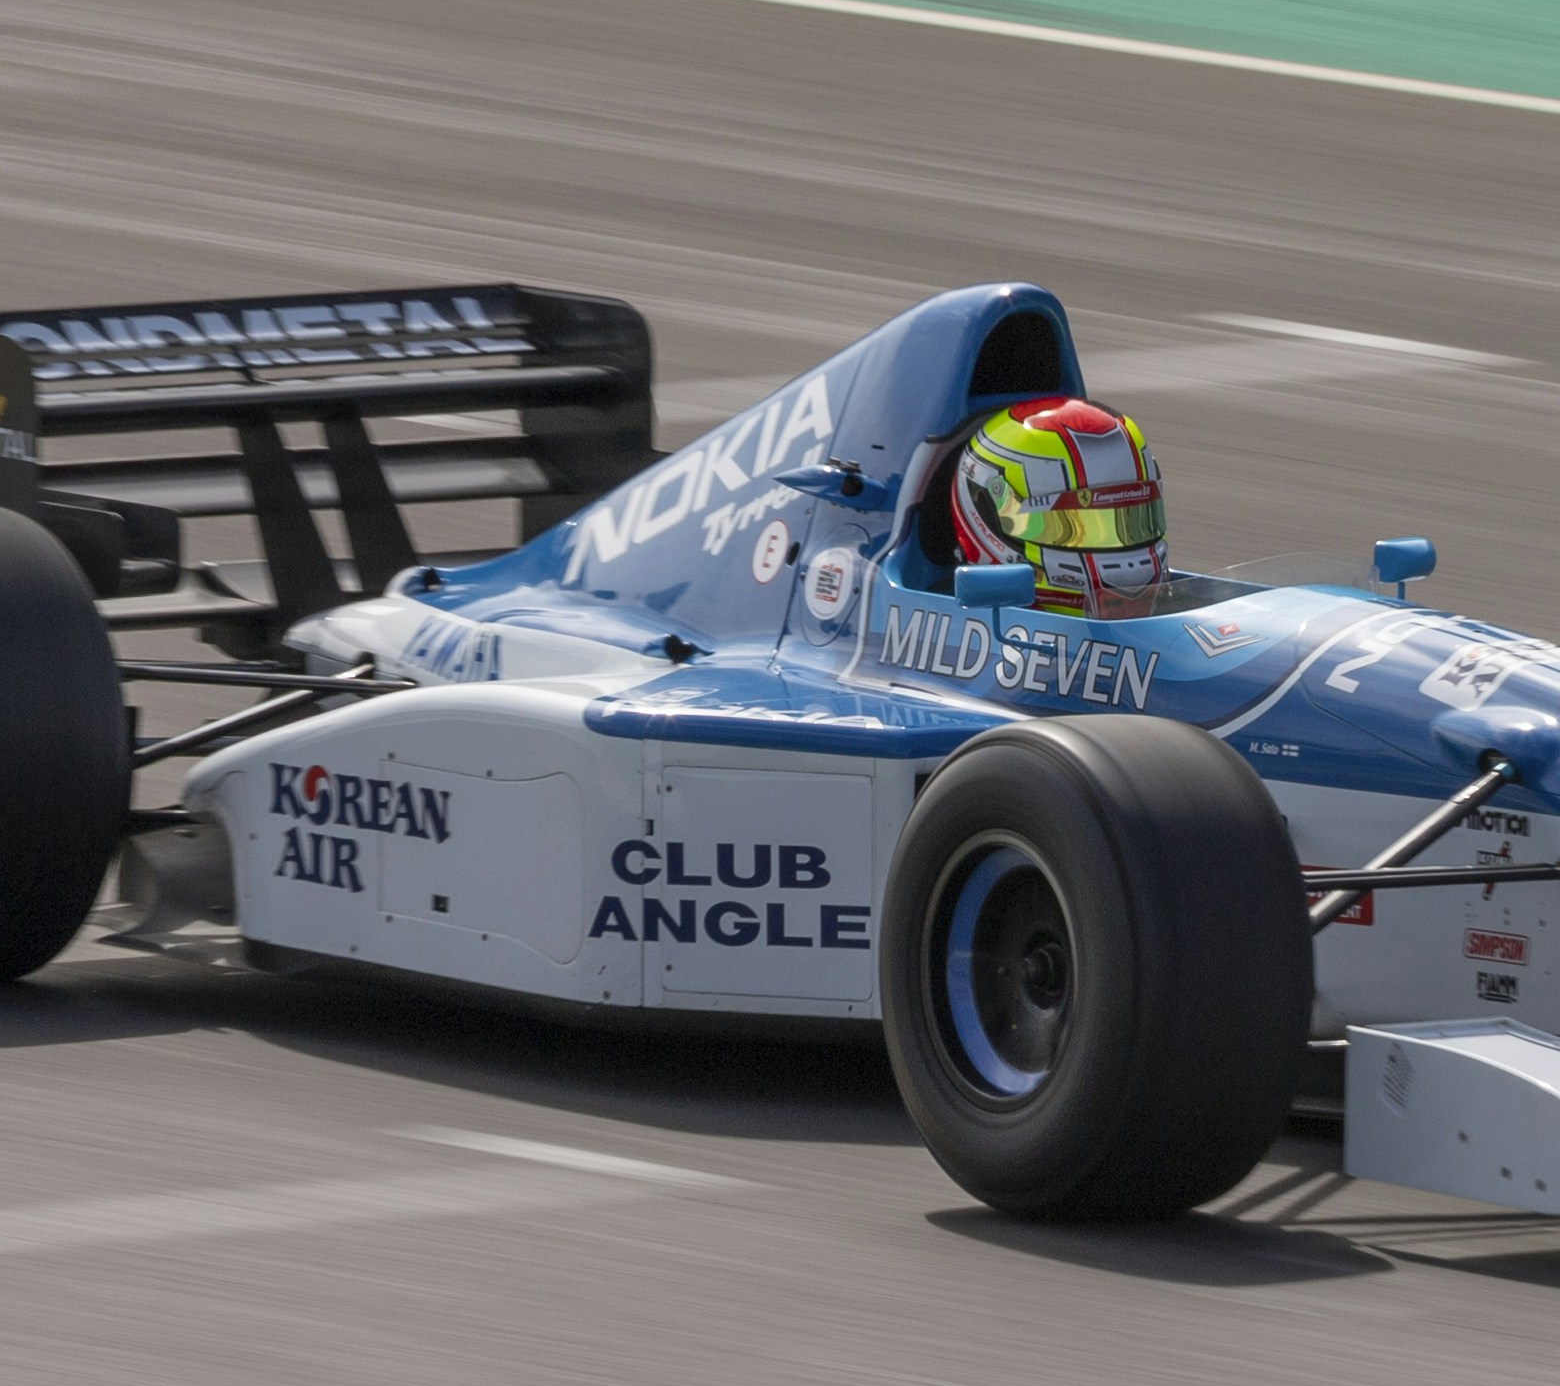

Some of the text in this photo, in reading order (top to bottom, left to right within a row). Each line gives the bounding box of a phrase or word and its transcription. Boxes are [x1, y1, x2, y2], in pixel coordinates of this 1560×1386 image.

[561, 372, 834, 586] NOKIA
[878, 605, 1160, 711] MILD SEVEN
[269, 762, 452, 844] KOREAN
[274, 826, 365, 893] AIR
[611, 839, 831, 889] CLUB
[588, 896, 871, 949] ANGLE
[1466, 932, 1525, 961] SIMPSON
